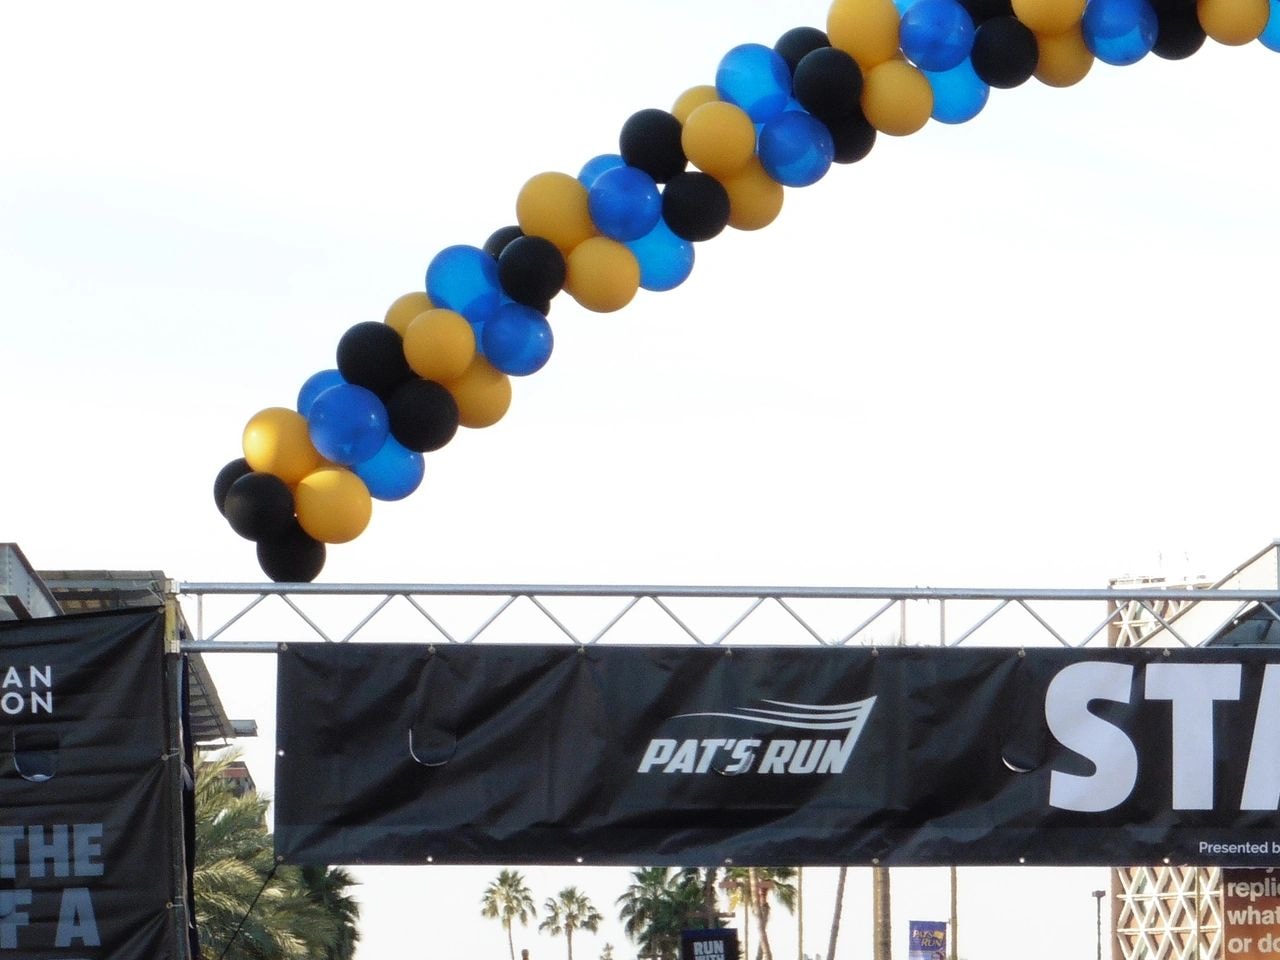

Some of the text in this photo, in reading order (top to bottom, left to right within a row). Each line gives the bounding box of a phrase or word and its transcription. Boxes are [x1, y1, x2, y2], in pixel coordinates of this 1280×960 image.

[637, 738, 857, 775] PAT'S RUN
[1199, 841, 1270, 854] Presented
[55, 887, 102, 947] A
[693, 940, 725, 956] RUN
[1227, 937, 1252, 953] or
